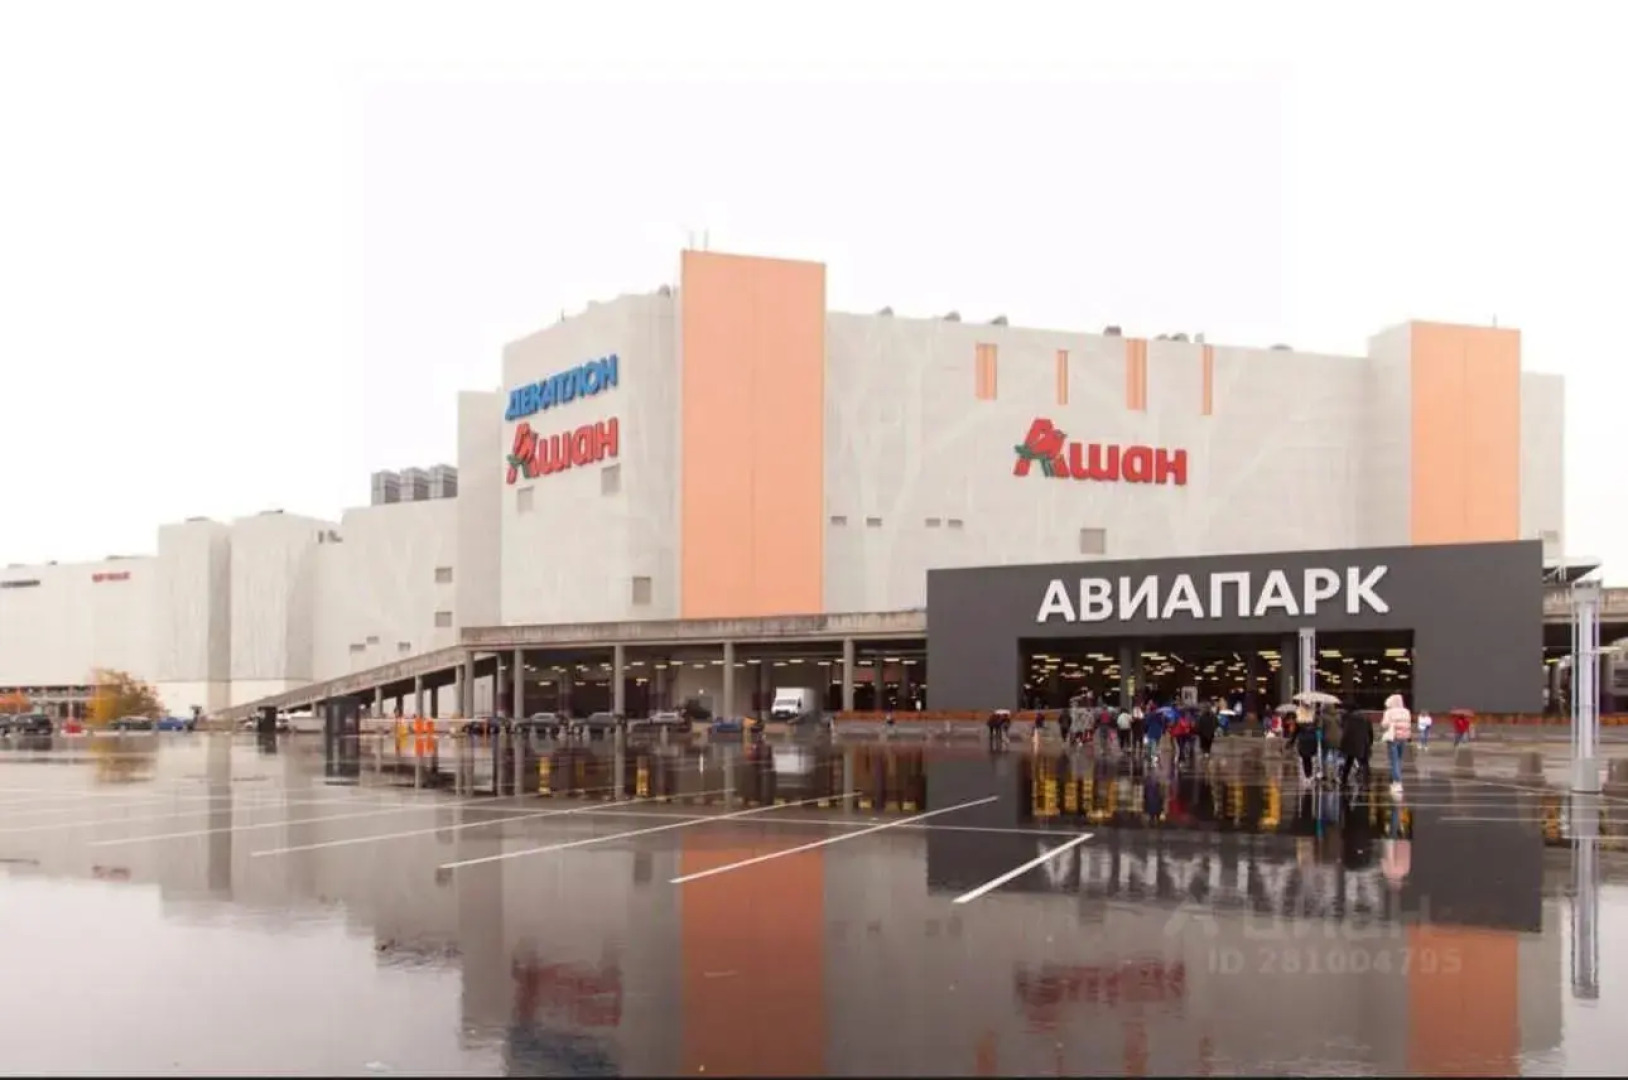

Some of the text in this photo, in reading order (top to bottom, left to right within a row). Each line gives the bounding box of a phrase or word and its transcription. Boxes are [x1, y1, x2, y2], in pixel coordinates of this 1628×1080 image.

[505, 354, 618, 421] ДЕКАТЛОН
[1013, 418, 1188, 485] Ашан
[1036, 565, 1390, 623] АВИАПАРК
